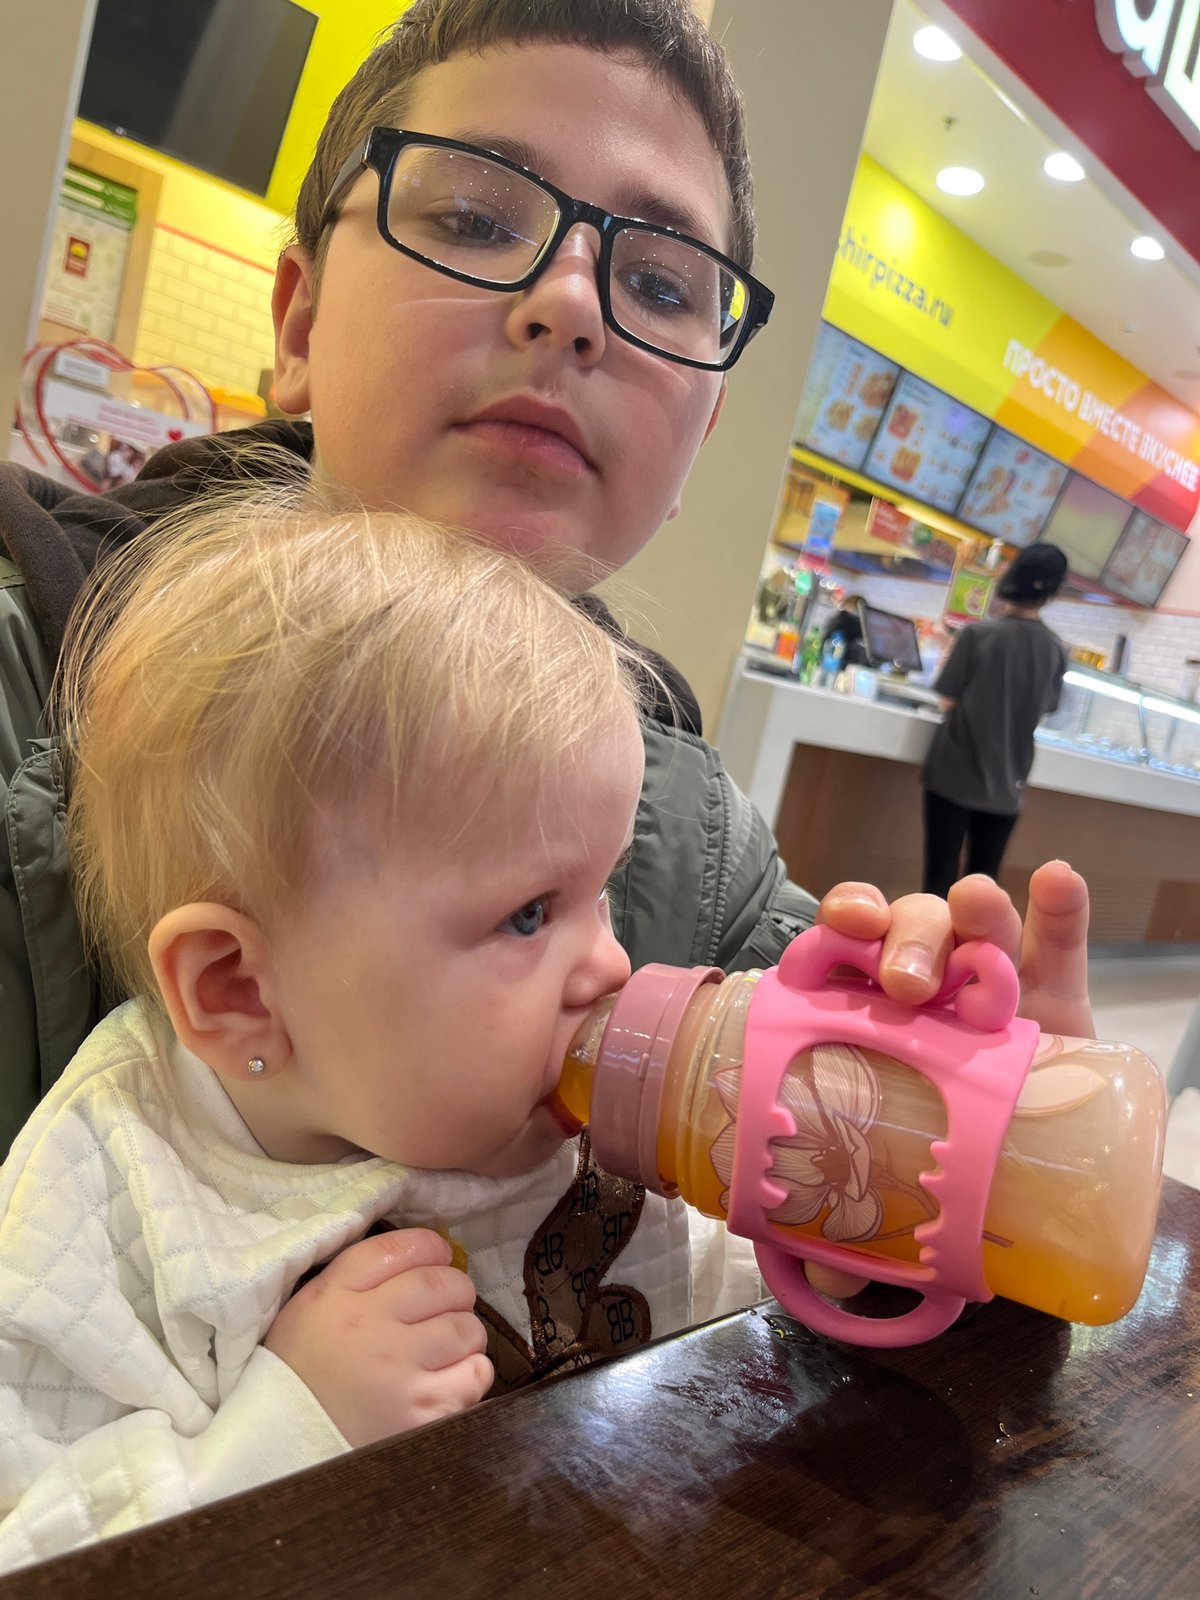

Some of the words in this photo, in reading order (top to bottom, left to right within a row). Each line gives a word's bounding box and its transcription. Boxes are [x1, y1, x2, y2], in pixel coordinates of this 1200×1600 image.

[838, 226, 955, 329] hirpizza.ru
[1002, 338, 1080, 412] ПРОСТО
[1073, 391, 1141, 454] ВМЕСТЕ
[1138, 430, 1200, 493] ВКУСНЕЕ
